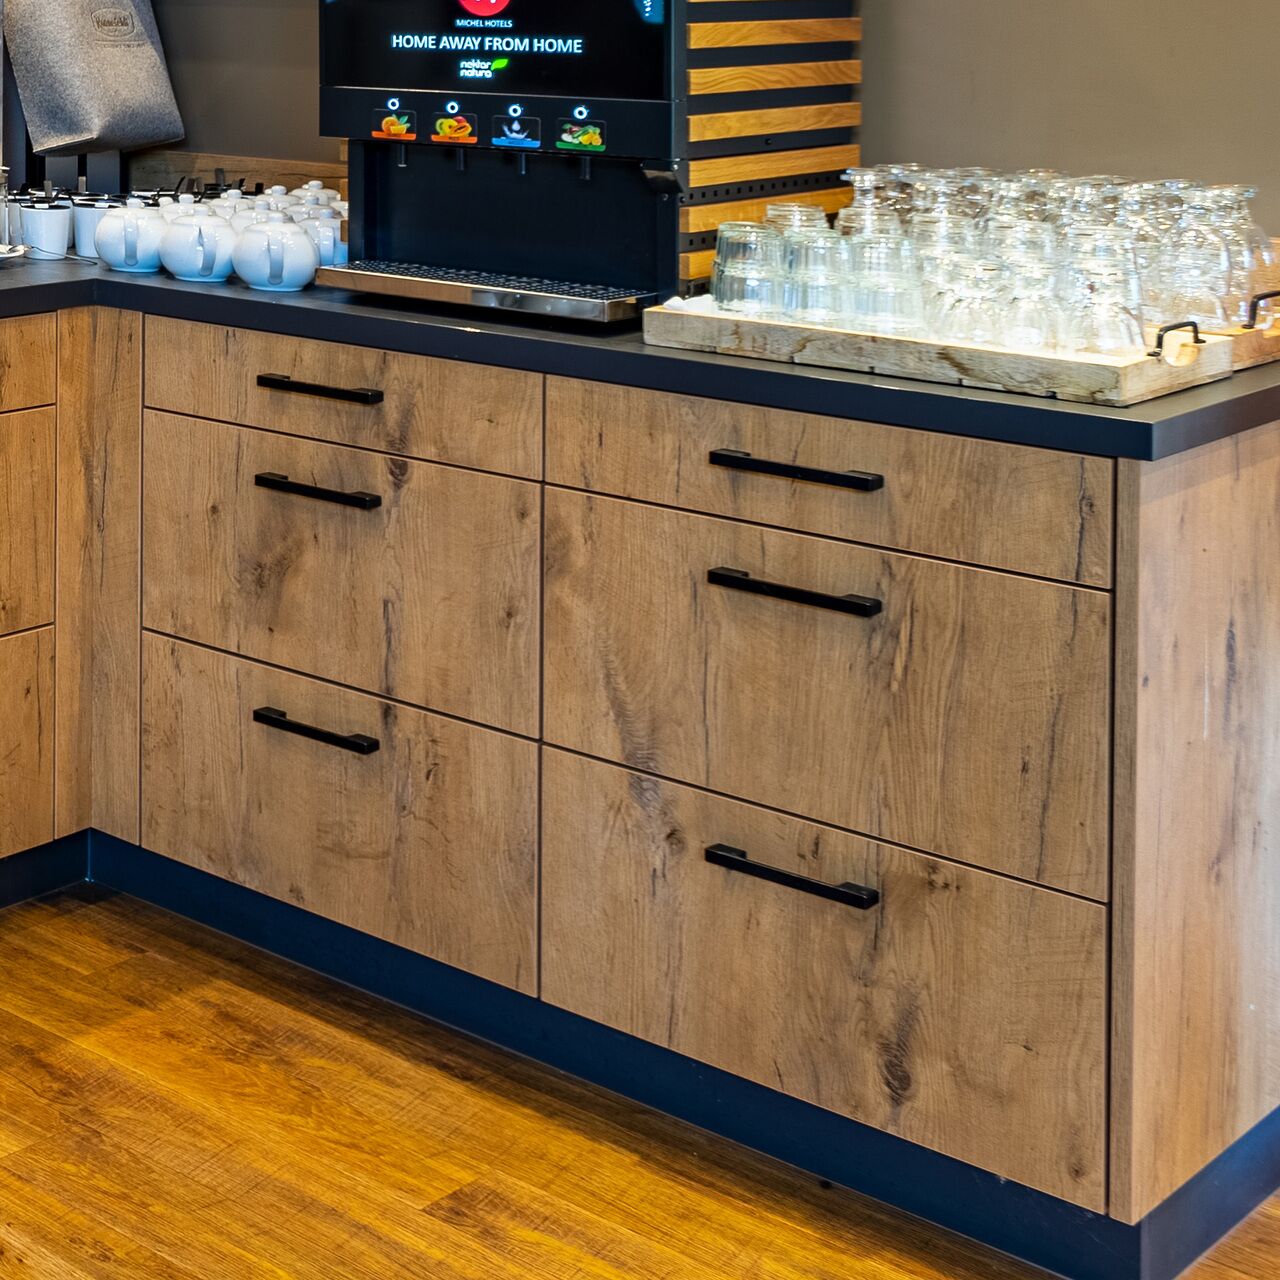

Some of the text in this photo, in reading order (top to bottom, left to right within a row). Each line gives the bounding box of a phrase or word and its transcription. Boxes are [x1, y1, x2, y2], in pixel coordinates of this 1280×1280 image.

[455, 19, 513, 28] MICHEL HOTELS
[392, 35, 583, 53] HOME AWAY FROM HOME
